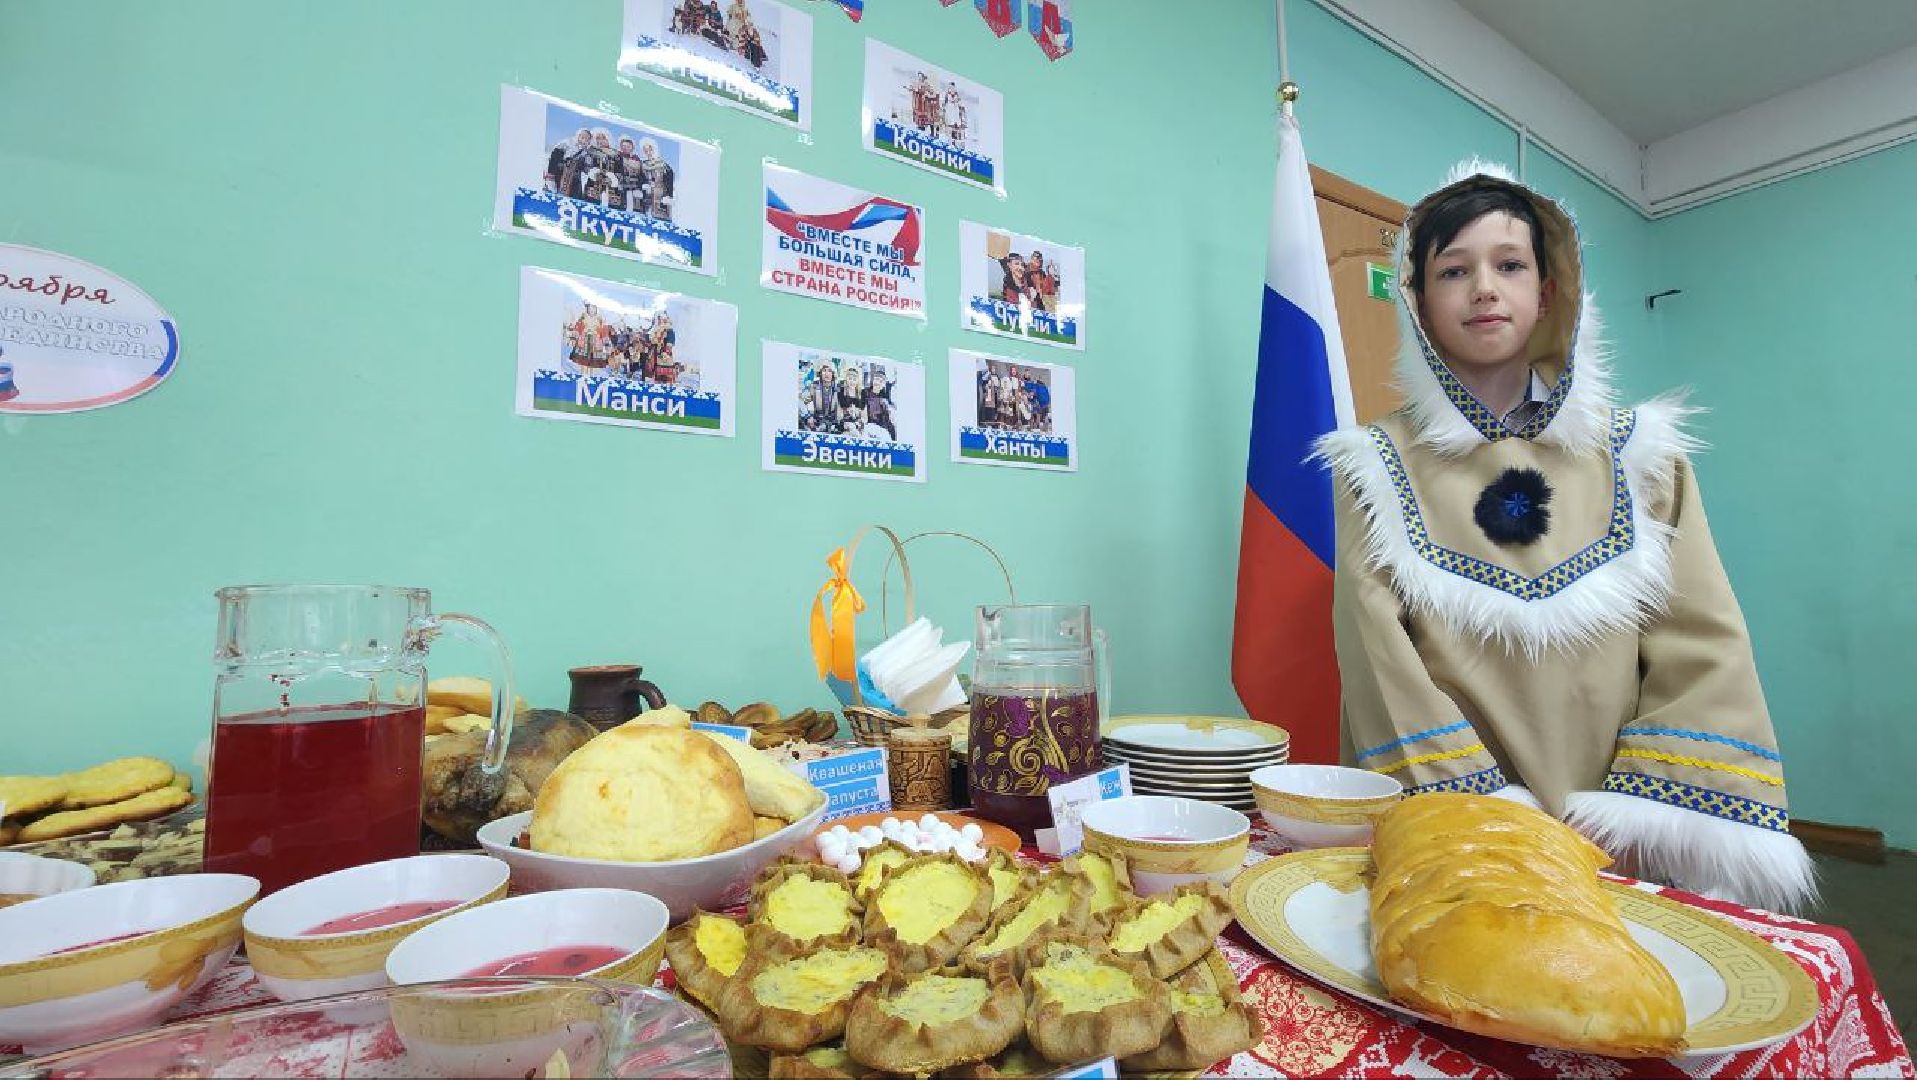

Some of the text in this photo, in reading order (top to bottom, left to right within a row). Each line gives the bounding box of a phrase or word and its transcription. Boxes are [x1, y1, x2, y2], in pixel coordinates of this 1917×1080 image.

[894, 126, 971, 173] Коряки
[779, 235, 916, 283] БОЛЬШАЯ СИЛА,
[877, 243, 904, 262] МЫ
[771, 270, 841, 297] СТРАНА
[800, 258, 898, 293] ВМЕСТЕ МЫ
[993, 300, 1051, 334] Чучи
[575, 378, 685, 418] Манси
[801, 437, 892, 470] Эвенки
[985, 431, 1046, 459] Ханты
[809, 760, 883, 781] Квашеная
[831, 788, 879, 807] апуста
